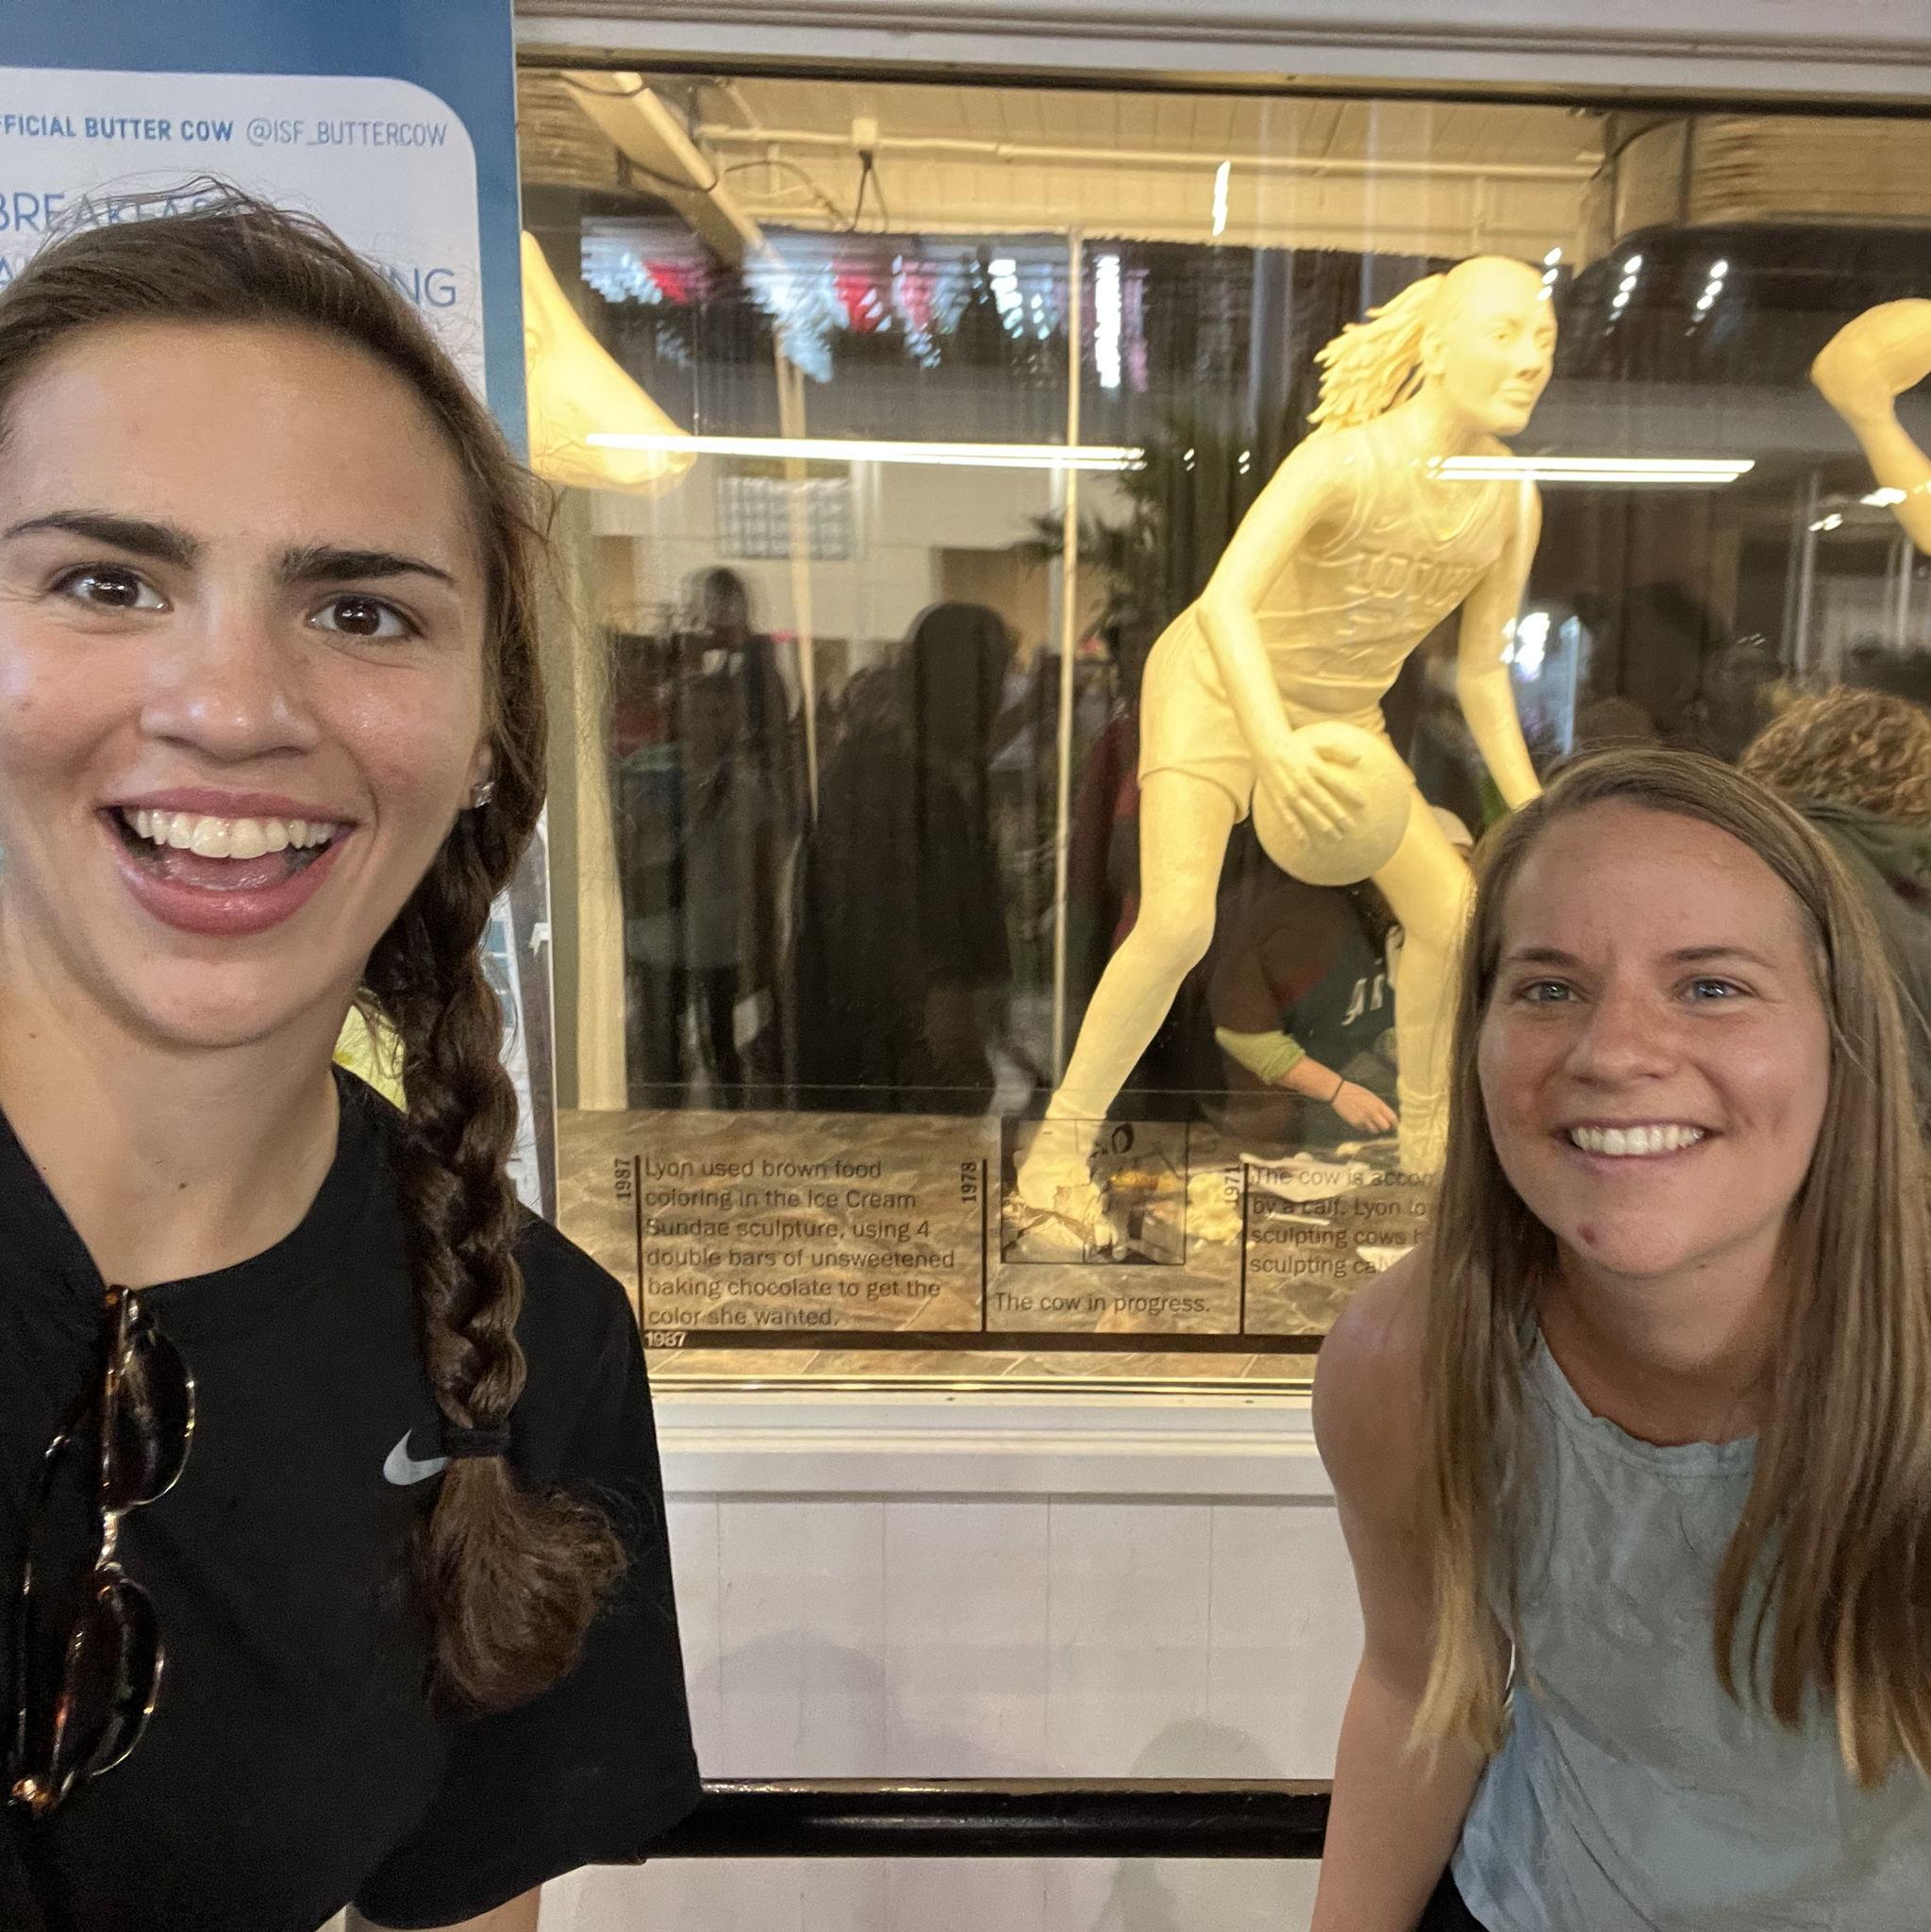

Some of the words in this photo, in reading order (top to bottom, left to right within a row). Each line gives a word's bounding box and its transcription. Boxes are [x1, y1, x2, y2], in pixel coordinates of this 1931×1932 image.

[85, 116, 172, 141] BUTTER
[180, 119, 234, 142] COW
[246, 118, 449, 147] @ISF_BUTTERCOW
[615, 1158, 631, 1200] 1987
[645, 1158, 693, 1180] Lyon
[703, 1159, 754, 1177] used
[762, 1159, 827, 1178] brown
[837, 1159, 882, 1178] food
[1299, 1171, 1340, 1186] cow
[1347, 1169, 1363, 1186] is
[960, 1161, 977, 1205] 1978
[1224, 1166, 1241, 1204] 1971
[645, 1189, 733, 1211] coloring
[740, 1190, 758, 1208] in
[765, 1190, 802, 1208] the
[808, 1190, 839, 1208] Ice
[846, 1190, 916, 1208] Cream
[1354, 1200, 1402, 1220] Lyon
[646, 1219, 729, 1237] Sundae
[735, 1220, 845, 1241] sculpture,
[853, 1221, 910, 1242] using
[916, 1221, 929, 1238] 4
[1251, 1227, 1347, 1249] sculpting
[1353, 1229, 1407, 1245] cows
[646, 1248, 722, 1267] double
[728, 1249, 776, 1267] bars
[783, 1250, 804, 1267] of
[811, 1251, 955, 1268] unsweetened
[1250, 1255, 1347, 1277] sculpting
[648, 1277, 723, 1300] baking
[727, 1279, 832, 1296] chocolate
[839, 1281, 860, 1297] to
[866, 1281, 899, 1302] get
[907, 1281, 941, 1297] the
[993, 1292, 1032, 1310] The
[1040, 1296, 1081, 1310] cow
[1087, 1293, 1106, 1310] in
[1114, 1296, 1211, 1316] progress.
[648, 1307, 703, 1325] color
[708, 1307, 747, 1325] she
[644, 1331, 686, 1347] 1987
